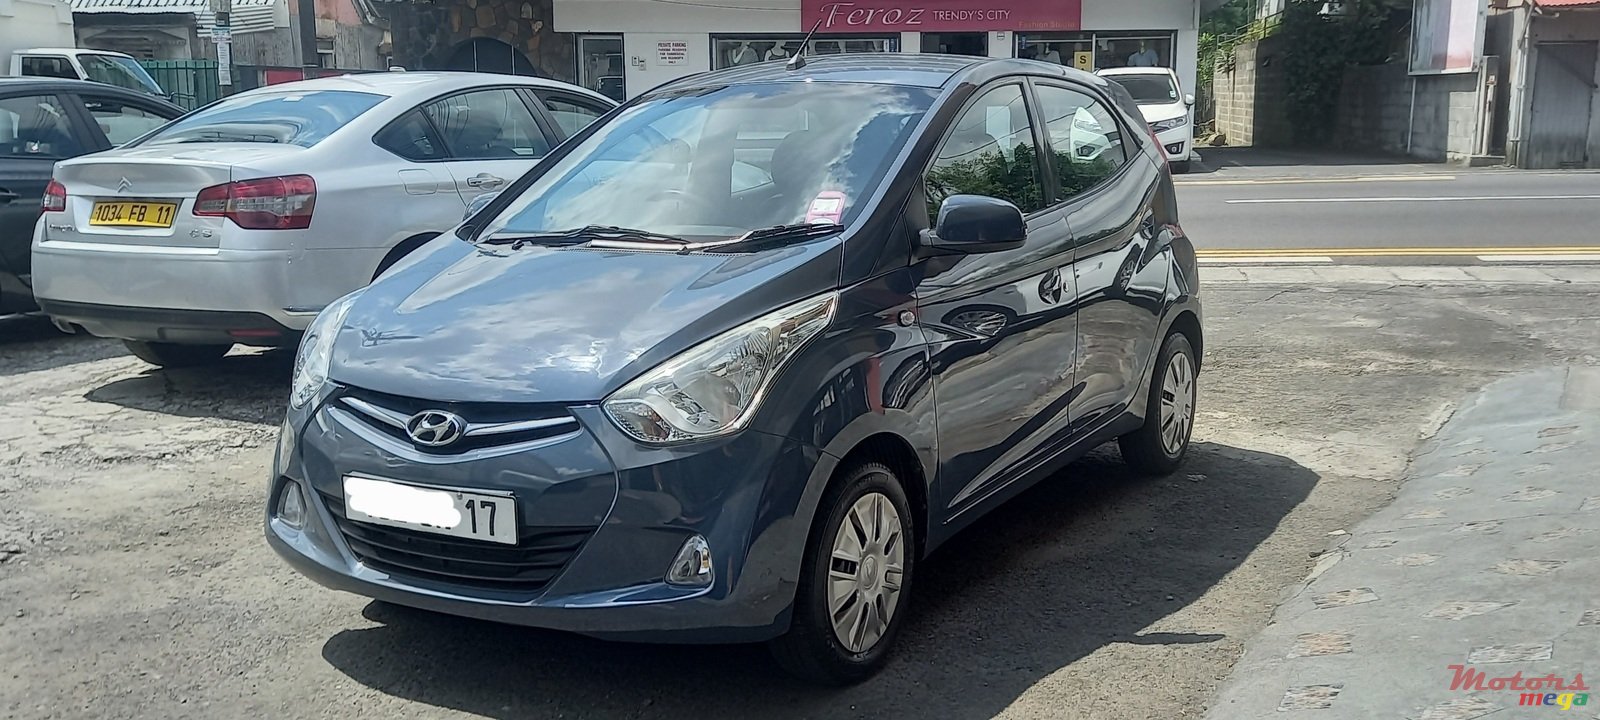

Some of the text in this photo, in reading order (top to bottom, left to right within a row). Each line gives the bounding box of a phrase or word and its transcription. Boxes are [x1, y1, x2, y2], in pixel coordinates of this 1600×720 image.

[820, 2, 925, 28] Feroz
[933, 10, 1011, 21] TRENDY'S CITY
[95, 204, 171, 224] 1034 FB 11
[465, 499, 496, 536] 17
